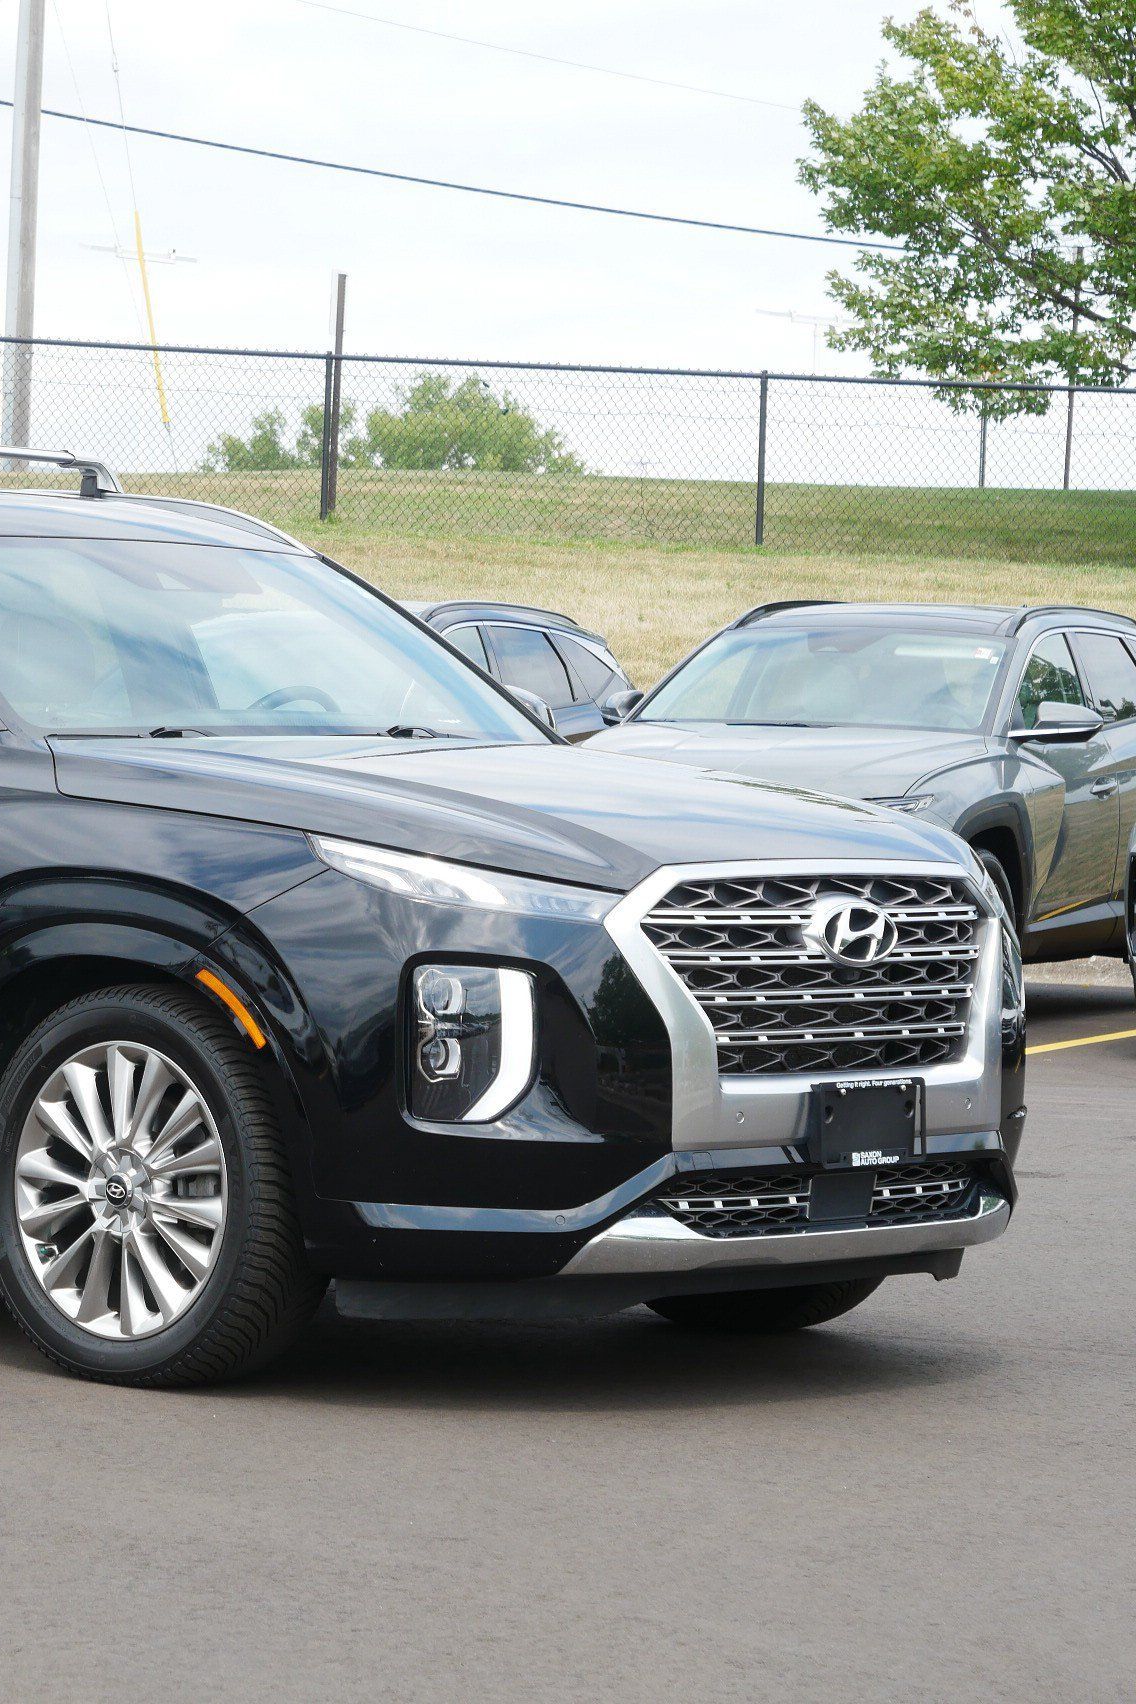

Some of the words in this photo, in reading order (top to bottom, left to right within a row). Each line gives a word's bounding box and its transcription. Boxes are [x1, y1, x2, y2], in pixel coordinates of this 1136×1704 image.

[836, 1081, 854, 1089] Getting
[860, 1157, 877, 1166] AUTO
[877, 1156, 900, 1165] GROUP
